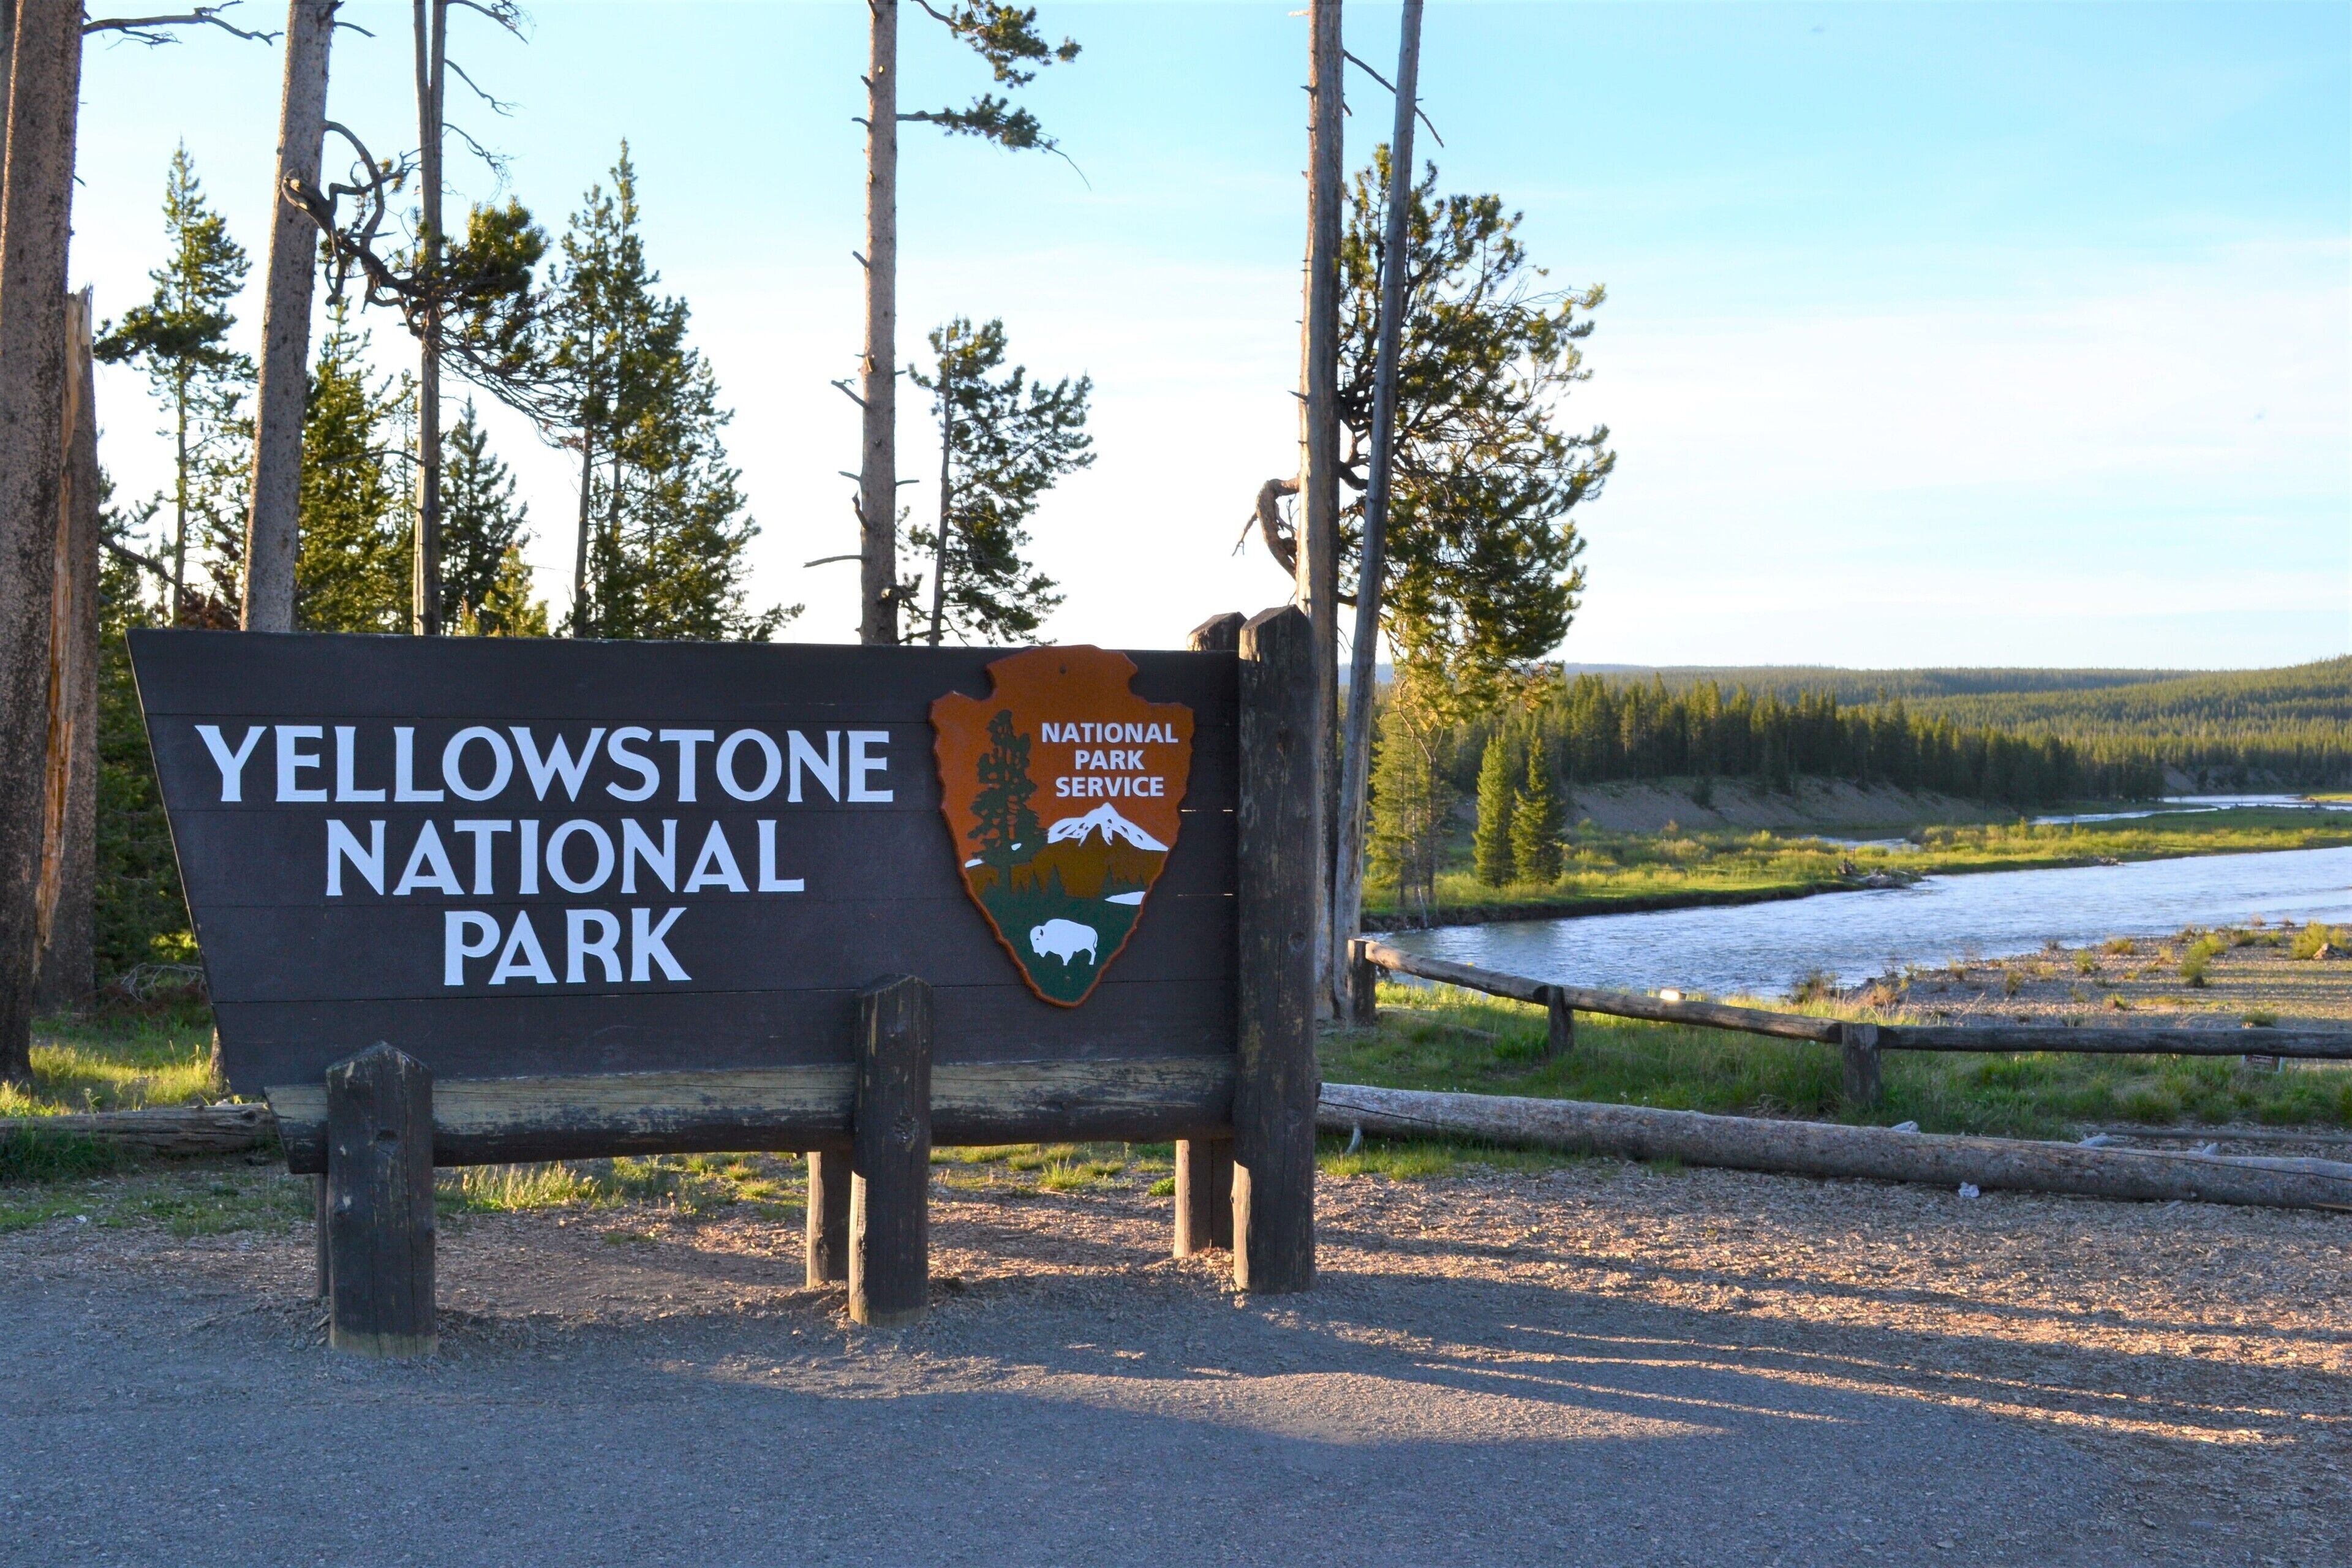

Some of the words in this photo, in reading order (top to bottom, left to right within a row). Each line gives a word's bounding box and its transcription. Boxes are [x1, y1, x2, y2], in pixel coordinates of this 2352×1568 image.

[1041, 723, 1178, 743] NATIONAL
[195, 725, 894, 803] YELLOWSTONE
[1075, 750, 1145, 770] PARK
[1055, 777, 1164, 797] SERVICE
[326, 818, 804, 896] NATIONAL
[443, 907, 692, 986] PARK
